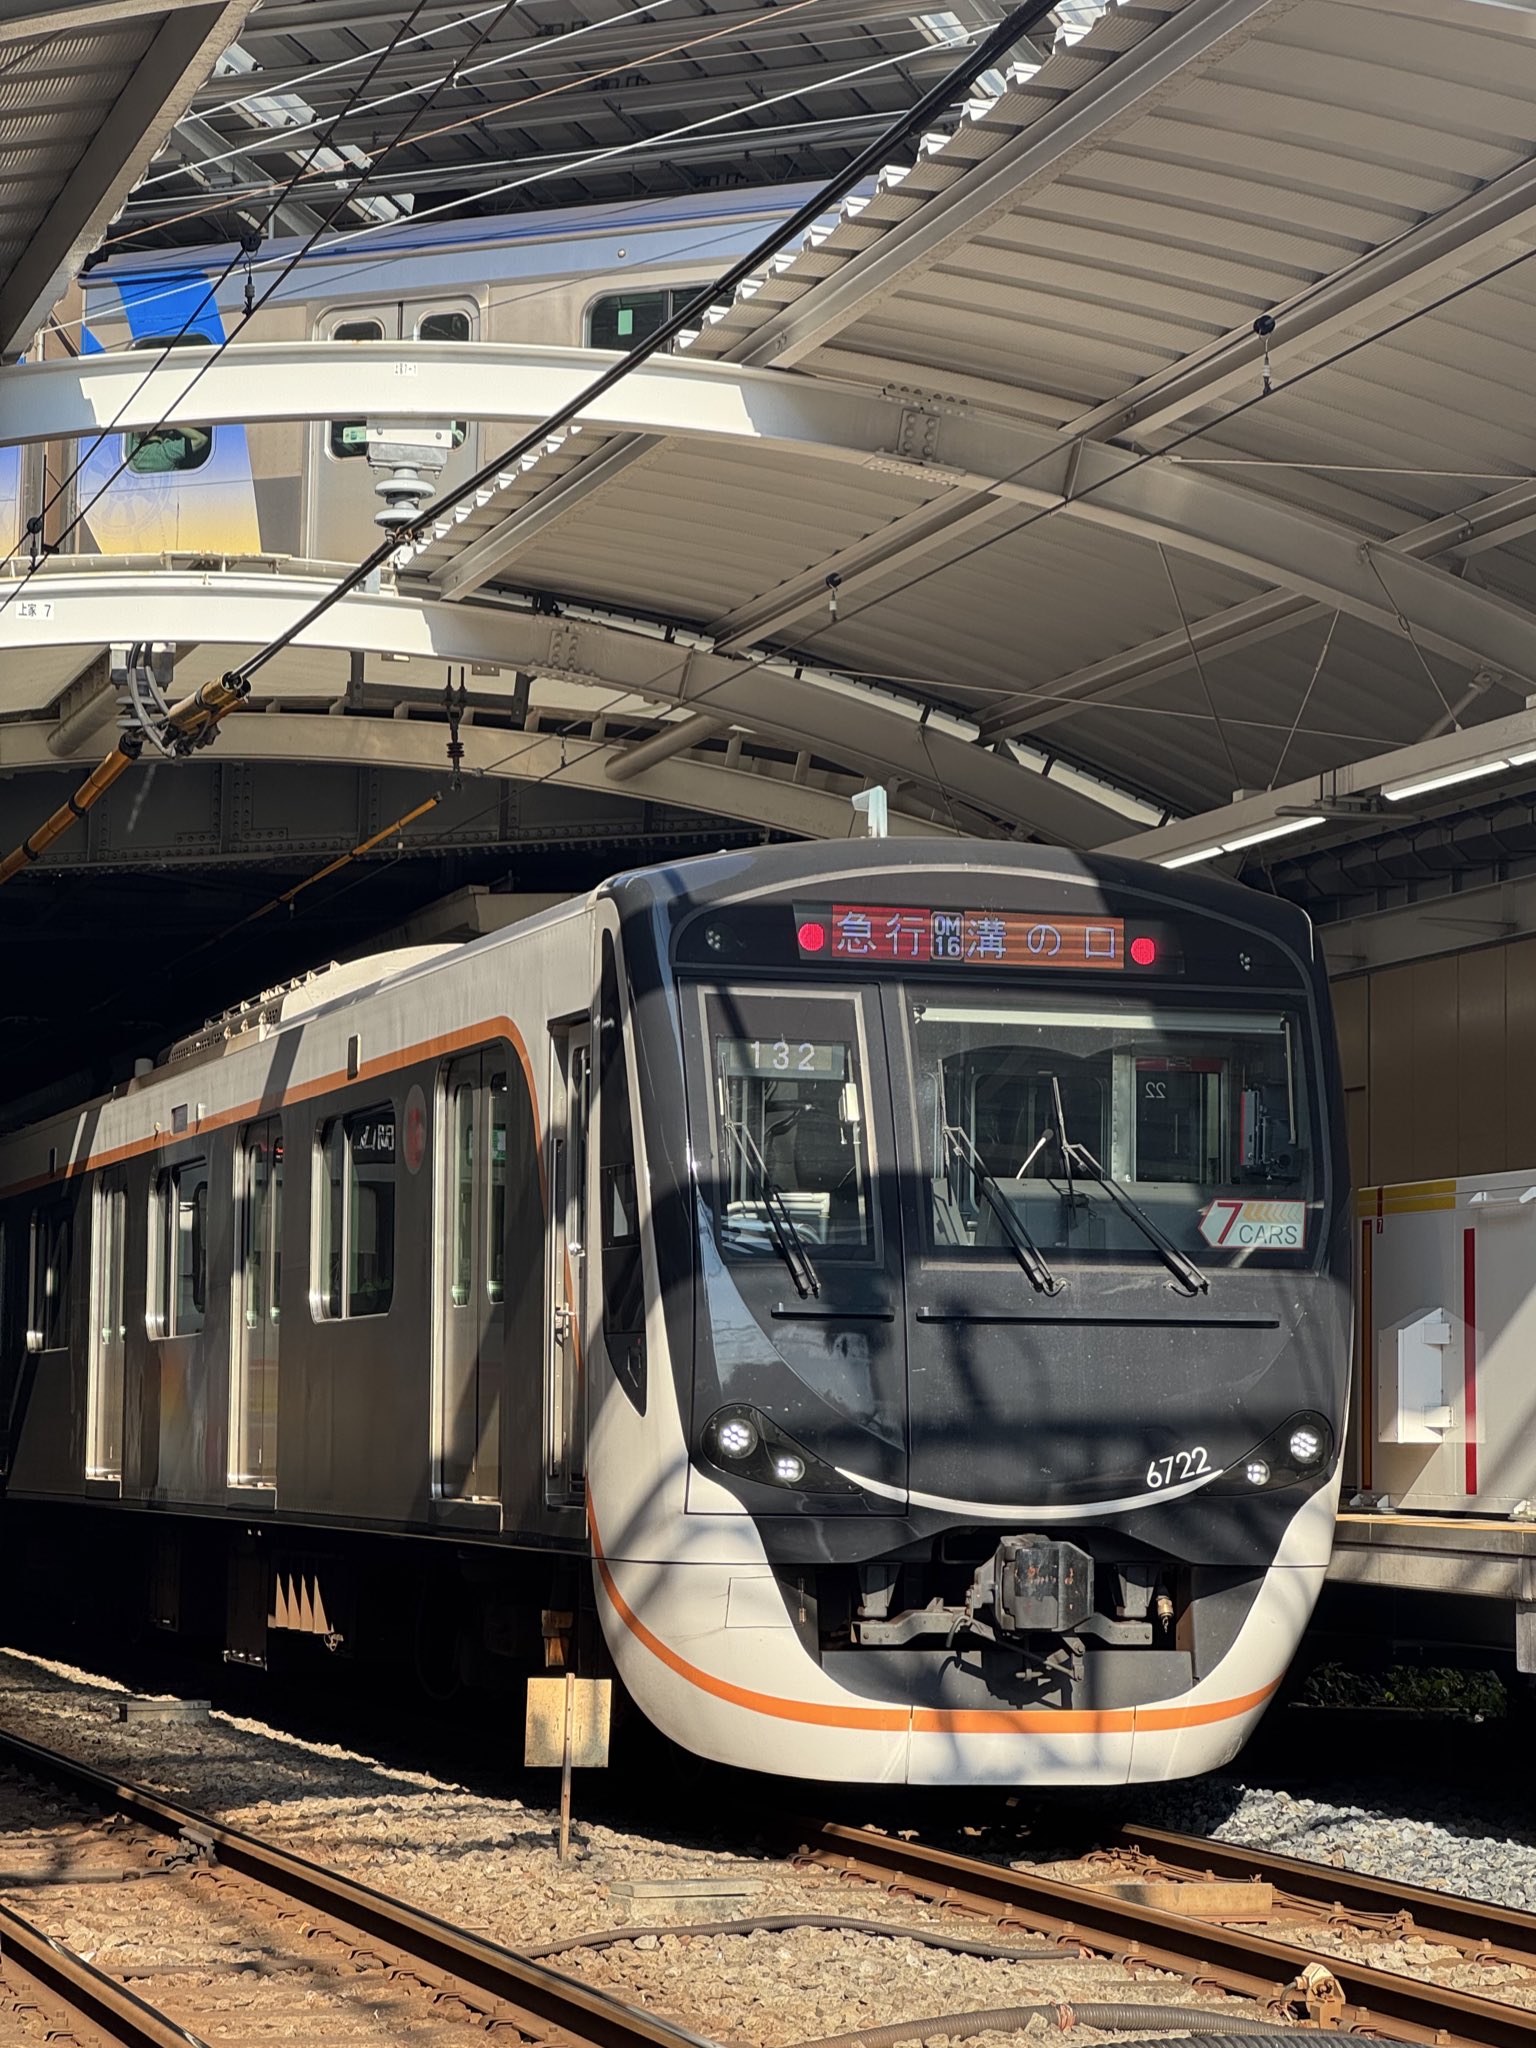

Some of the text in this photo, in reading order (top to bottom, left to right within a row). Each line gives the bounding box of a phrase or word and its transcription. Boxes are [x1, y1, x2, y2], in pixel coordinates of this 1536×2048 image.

[18, 602, 51, 618] 上家 7
[837, 911, 926, 955] 急行
[935, 936, 960, 956] 16
[966, 917, 1115, 959] 溝の口
[750, 1040, 816, 1071] 132
[1217, 1202, 1298, 1245] 7 CARS
[1147, 1446, 1212, 1488] 6722
